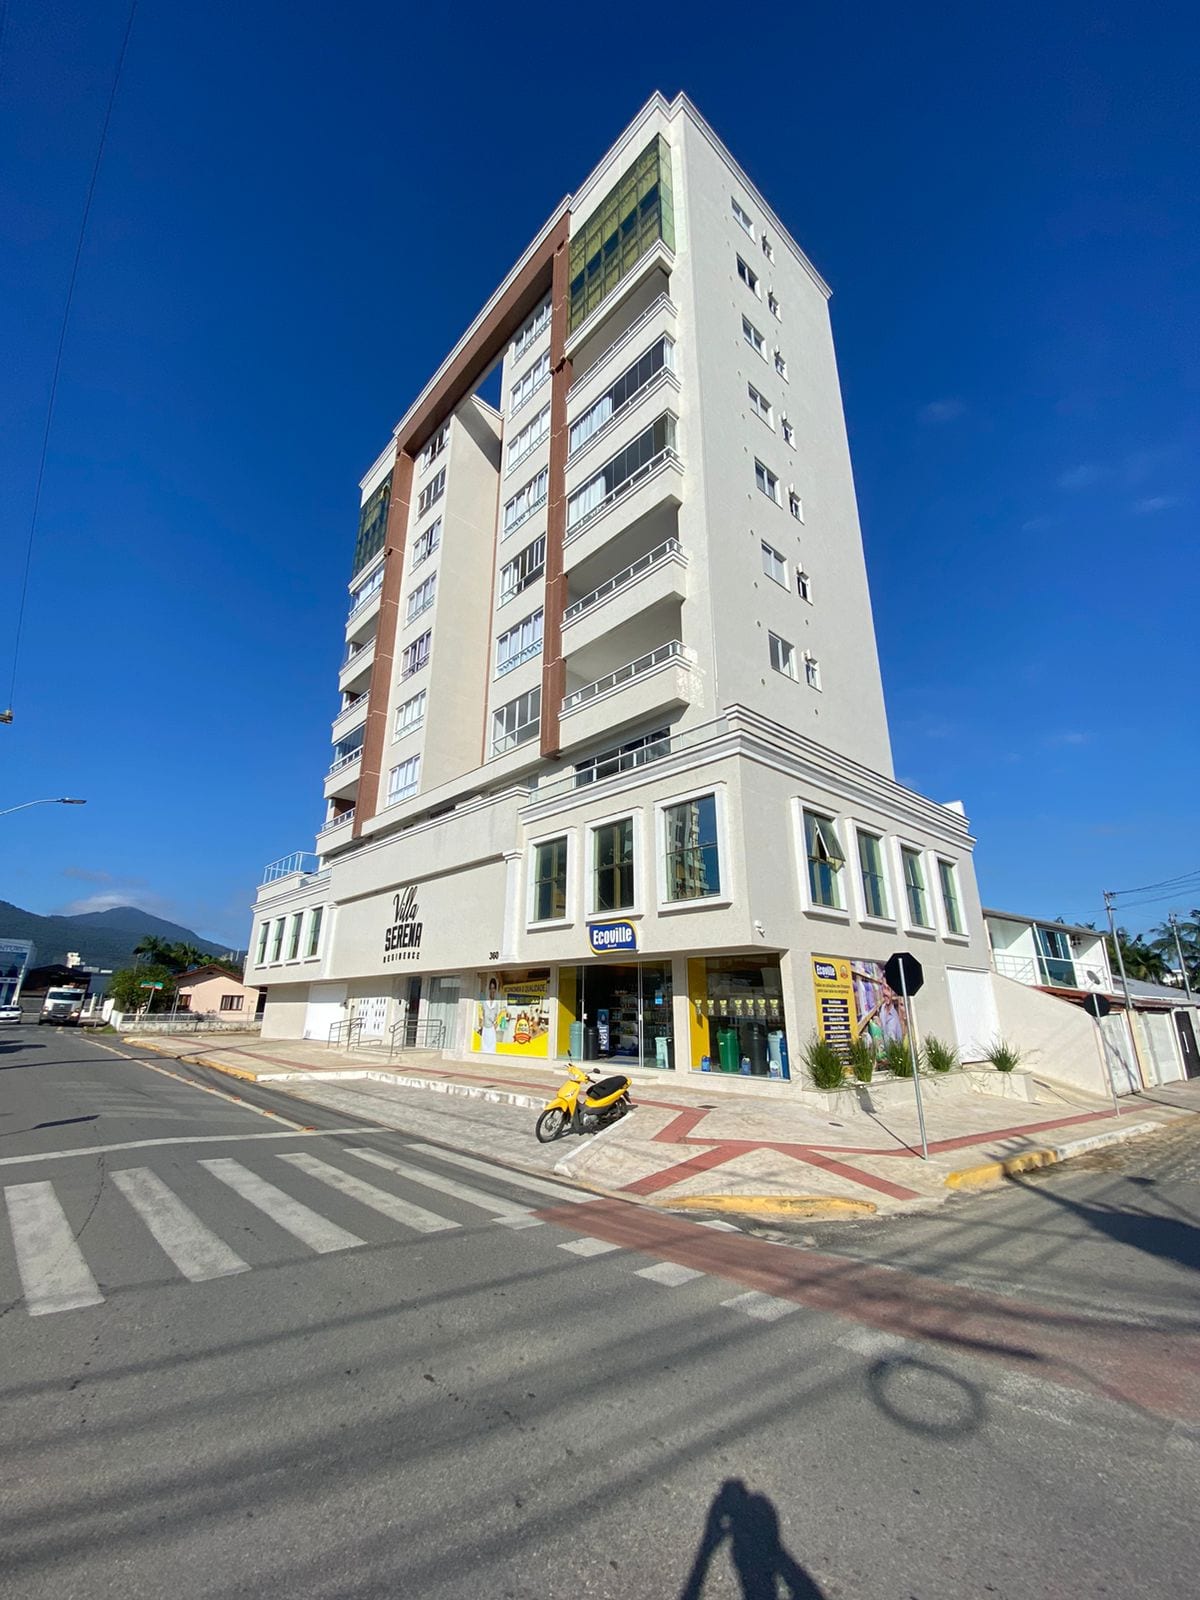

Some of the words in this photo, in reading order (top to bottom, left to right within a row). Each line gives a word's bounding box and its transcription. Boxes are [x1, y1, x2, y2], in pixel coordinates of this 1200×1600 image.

[393, 886, 419, 923] Villa
[385, 922, 423, 951] SERENA
[593, 927, 632, 945] Ecoville
[383, 952, 421, 963] RESIDENCE
